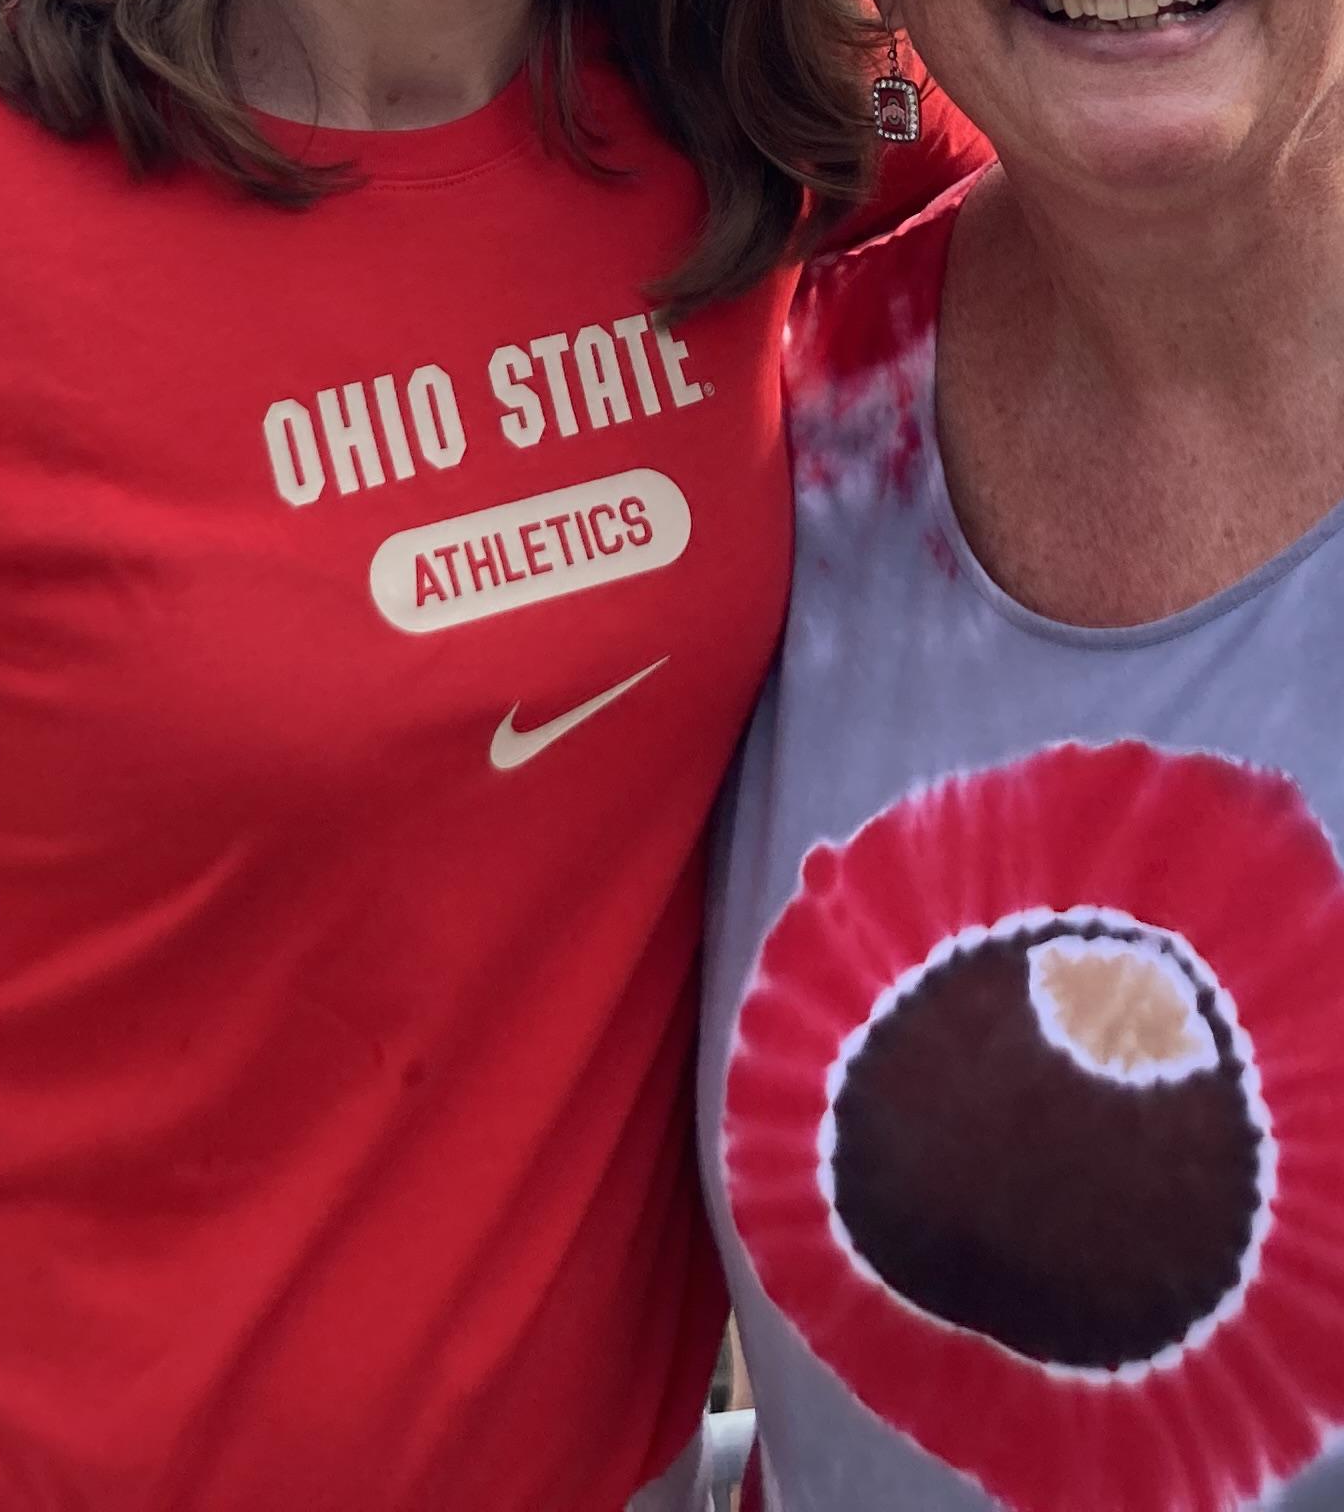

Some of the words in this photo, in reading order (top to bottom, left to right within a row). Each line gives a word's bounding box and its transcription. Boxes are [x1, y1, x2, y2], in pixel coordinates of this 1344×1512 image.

[263, 363, 468, 508] OHIO
[488, 309, 705, 448] STATE
[413, 495, 654, 608] ATHLETICS
